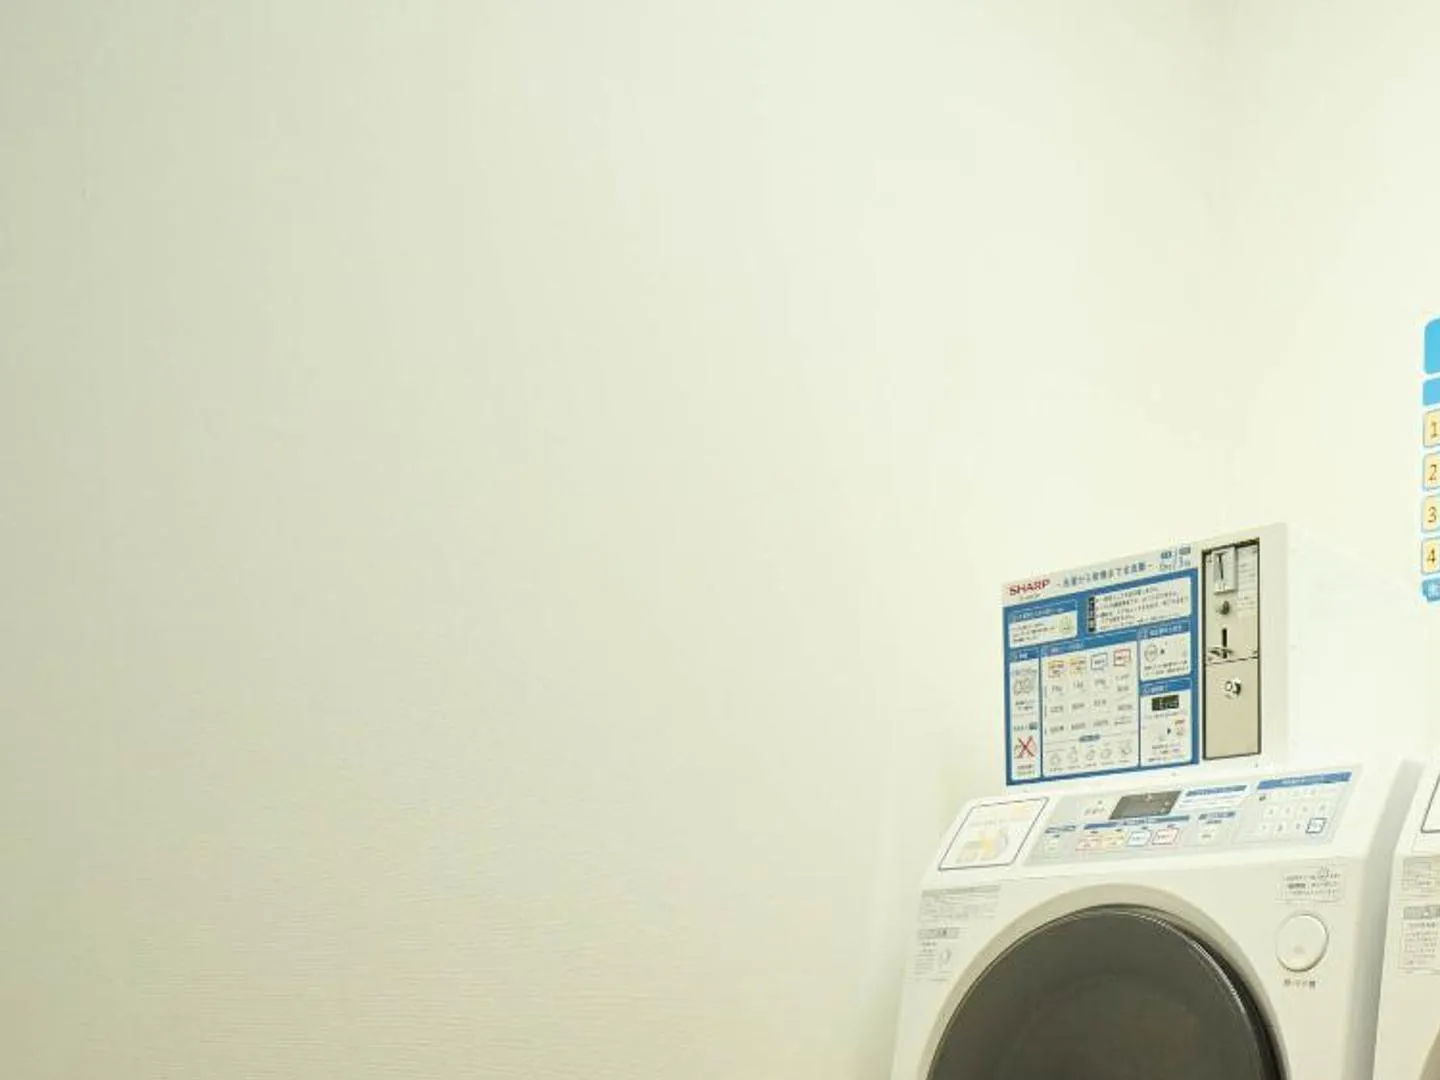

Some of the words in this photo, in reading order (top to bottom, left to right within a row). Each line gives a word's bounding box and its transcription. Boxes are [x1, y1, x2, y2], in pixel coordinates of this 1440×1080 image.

[1430, 421, 1438, 439] 1
[1428, 463, 1438, 481] 2
[1427, 506, 1437, 524] 3
[1427, 545, 1437, 563] 4
[1009, 578, 1051, 597] SHARP
